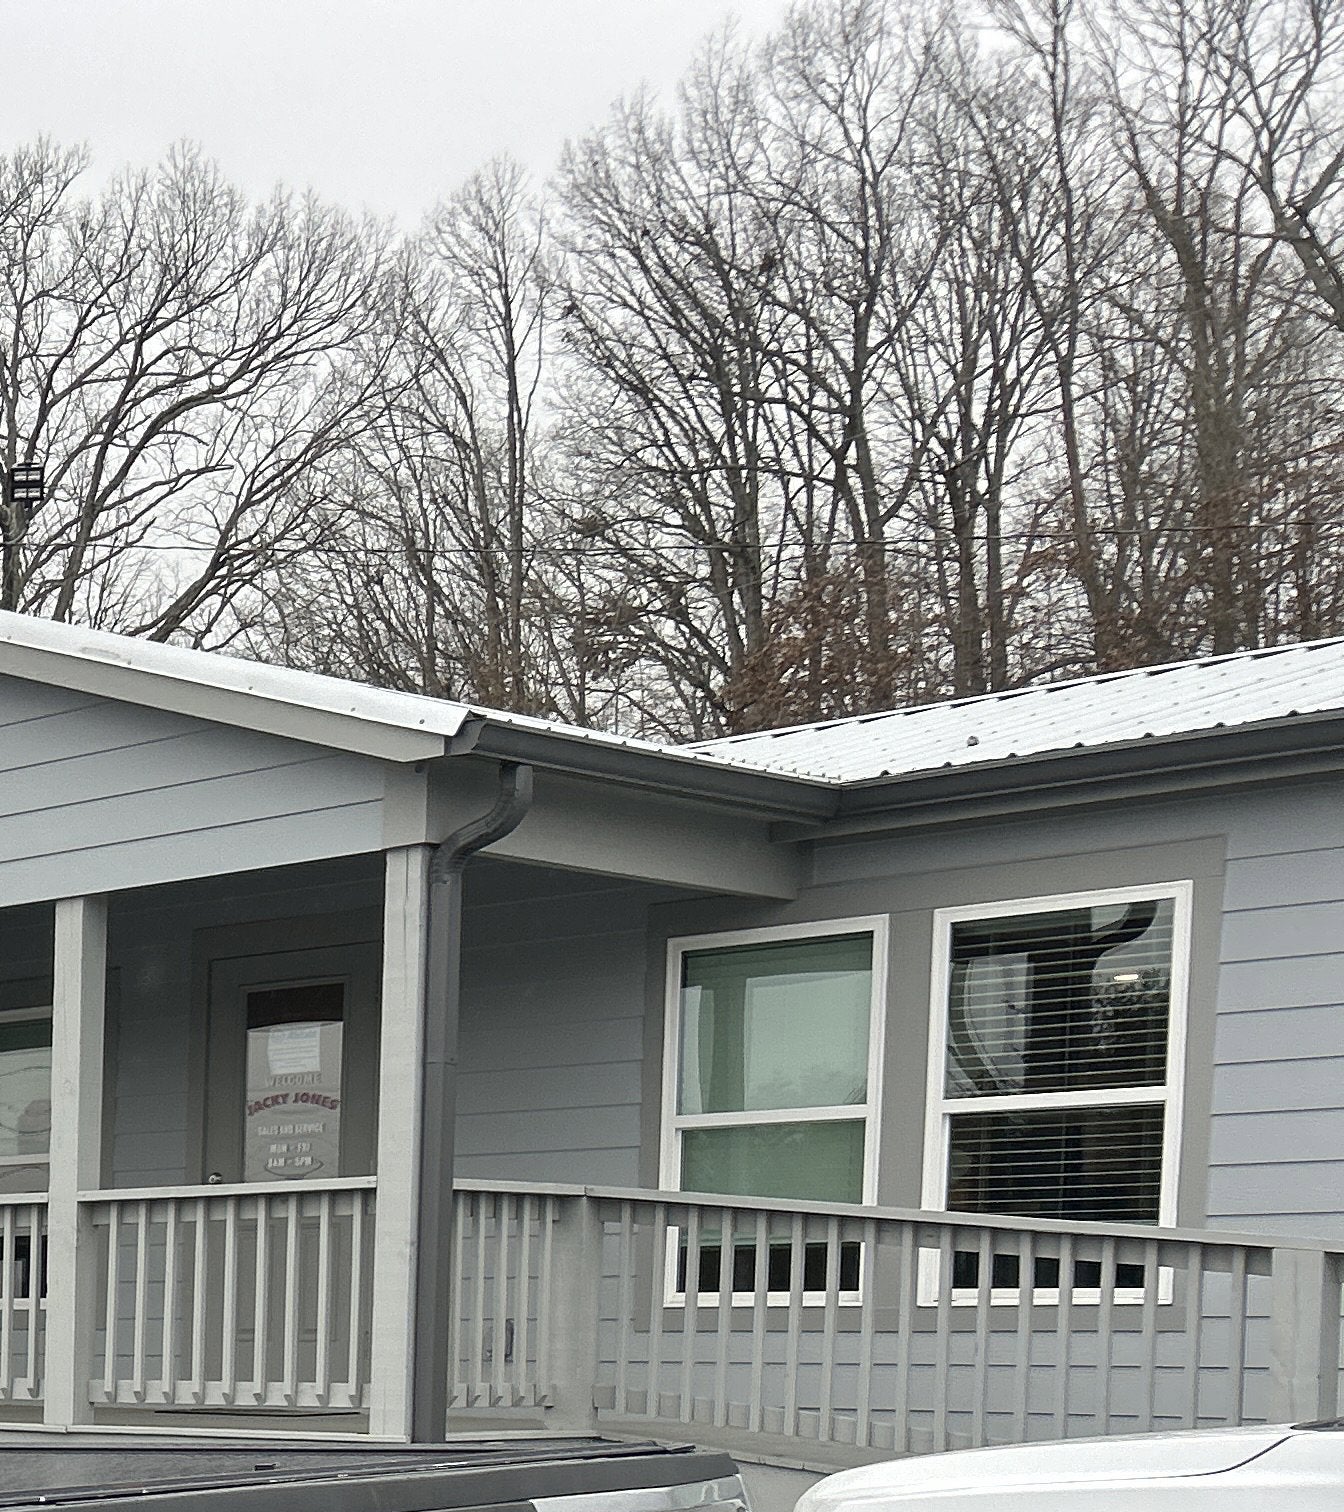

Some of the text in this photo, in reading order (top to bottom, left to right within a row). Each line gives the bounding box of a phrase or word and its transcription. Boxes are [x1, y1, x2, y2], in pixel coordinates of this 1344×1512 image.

[265, 1073, 322, 1087] WELCOME
[247, 1092, 340, 1117] JACKY JONES
